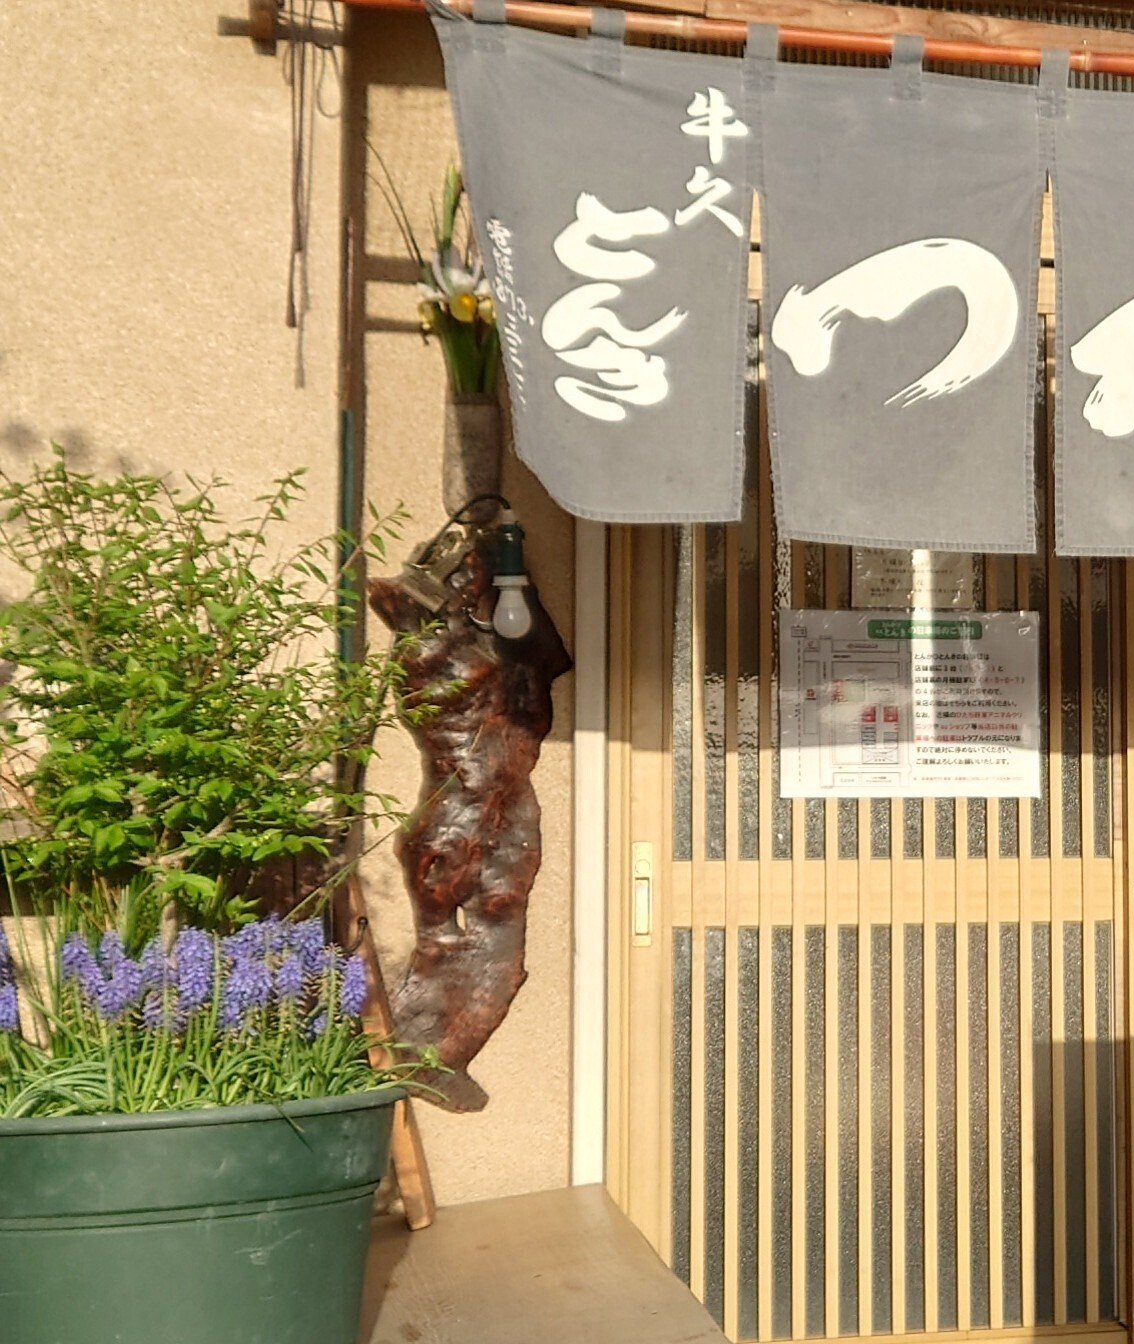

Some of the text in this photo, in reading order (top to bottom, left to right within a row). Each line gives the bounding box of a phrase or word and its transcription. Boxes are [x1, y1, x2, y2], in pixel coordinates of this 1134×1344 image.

[674, 87, 749, 238] 牛久
[542, 192, 688, 422] とんき
